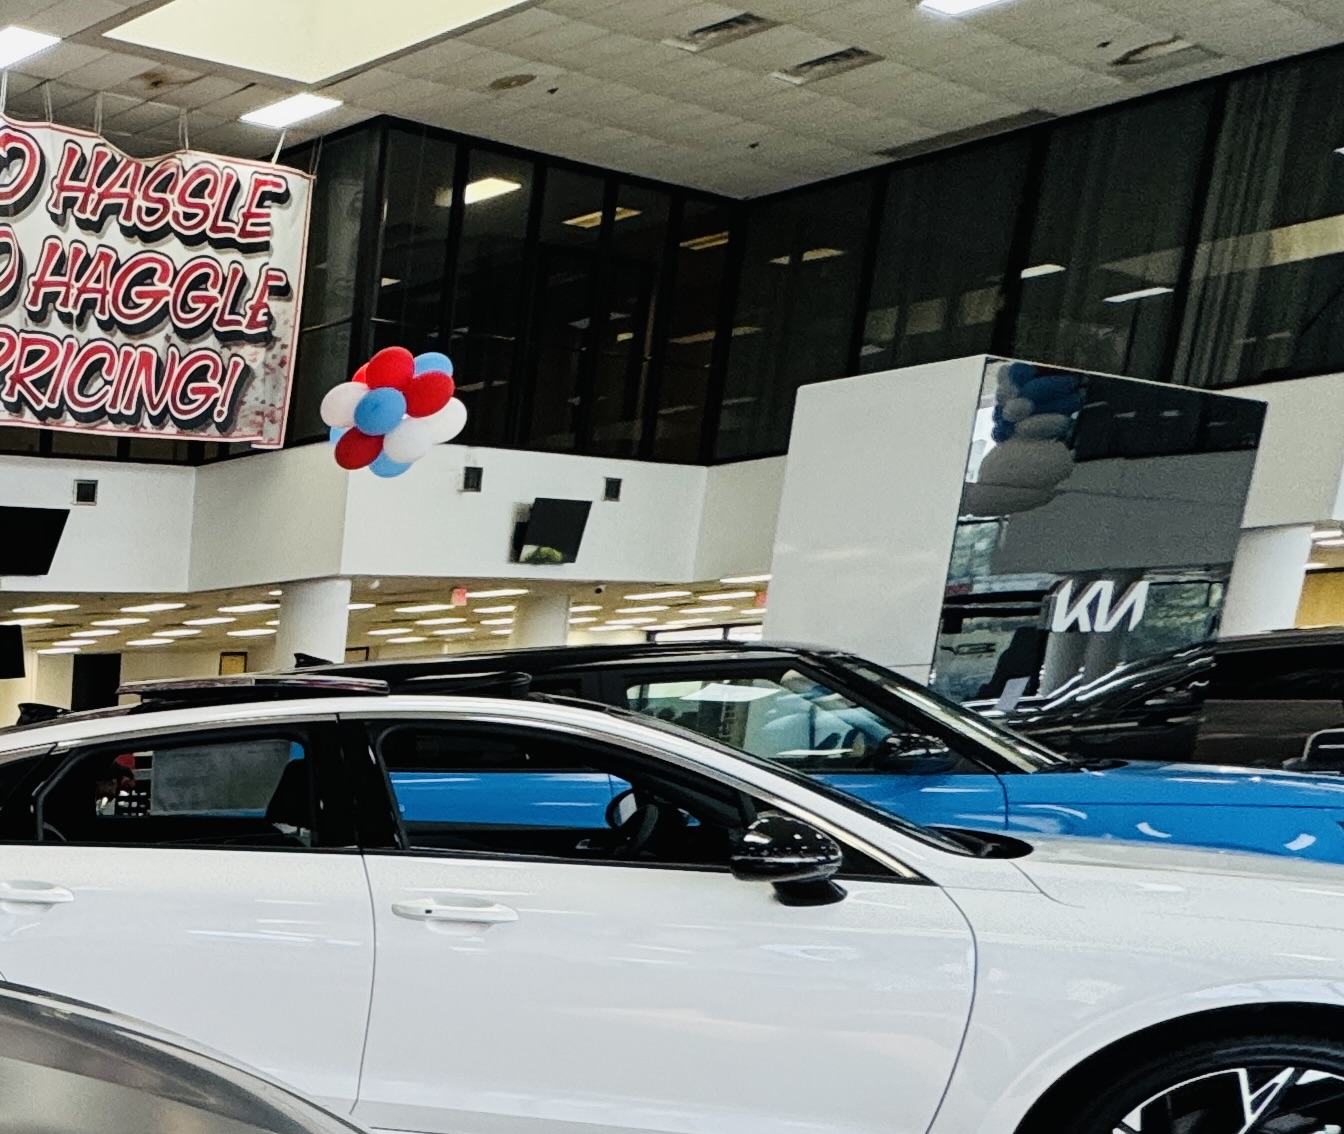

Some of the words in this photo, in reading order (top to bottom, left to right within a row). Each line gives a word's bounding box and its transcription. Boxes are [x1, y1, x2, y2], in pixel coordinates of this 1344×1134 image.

[49, 141, 289, 250] HASSLE
[25, 235, 291, 343] HAGGLE
[1052, 579, 1150, 632] KIA
